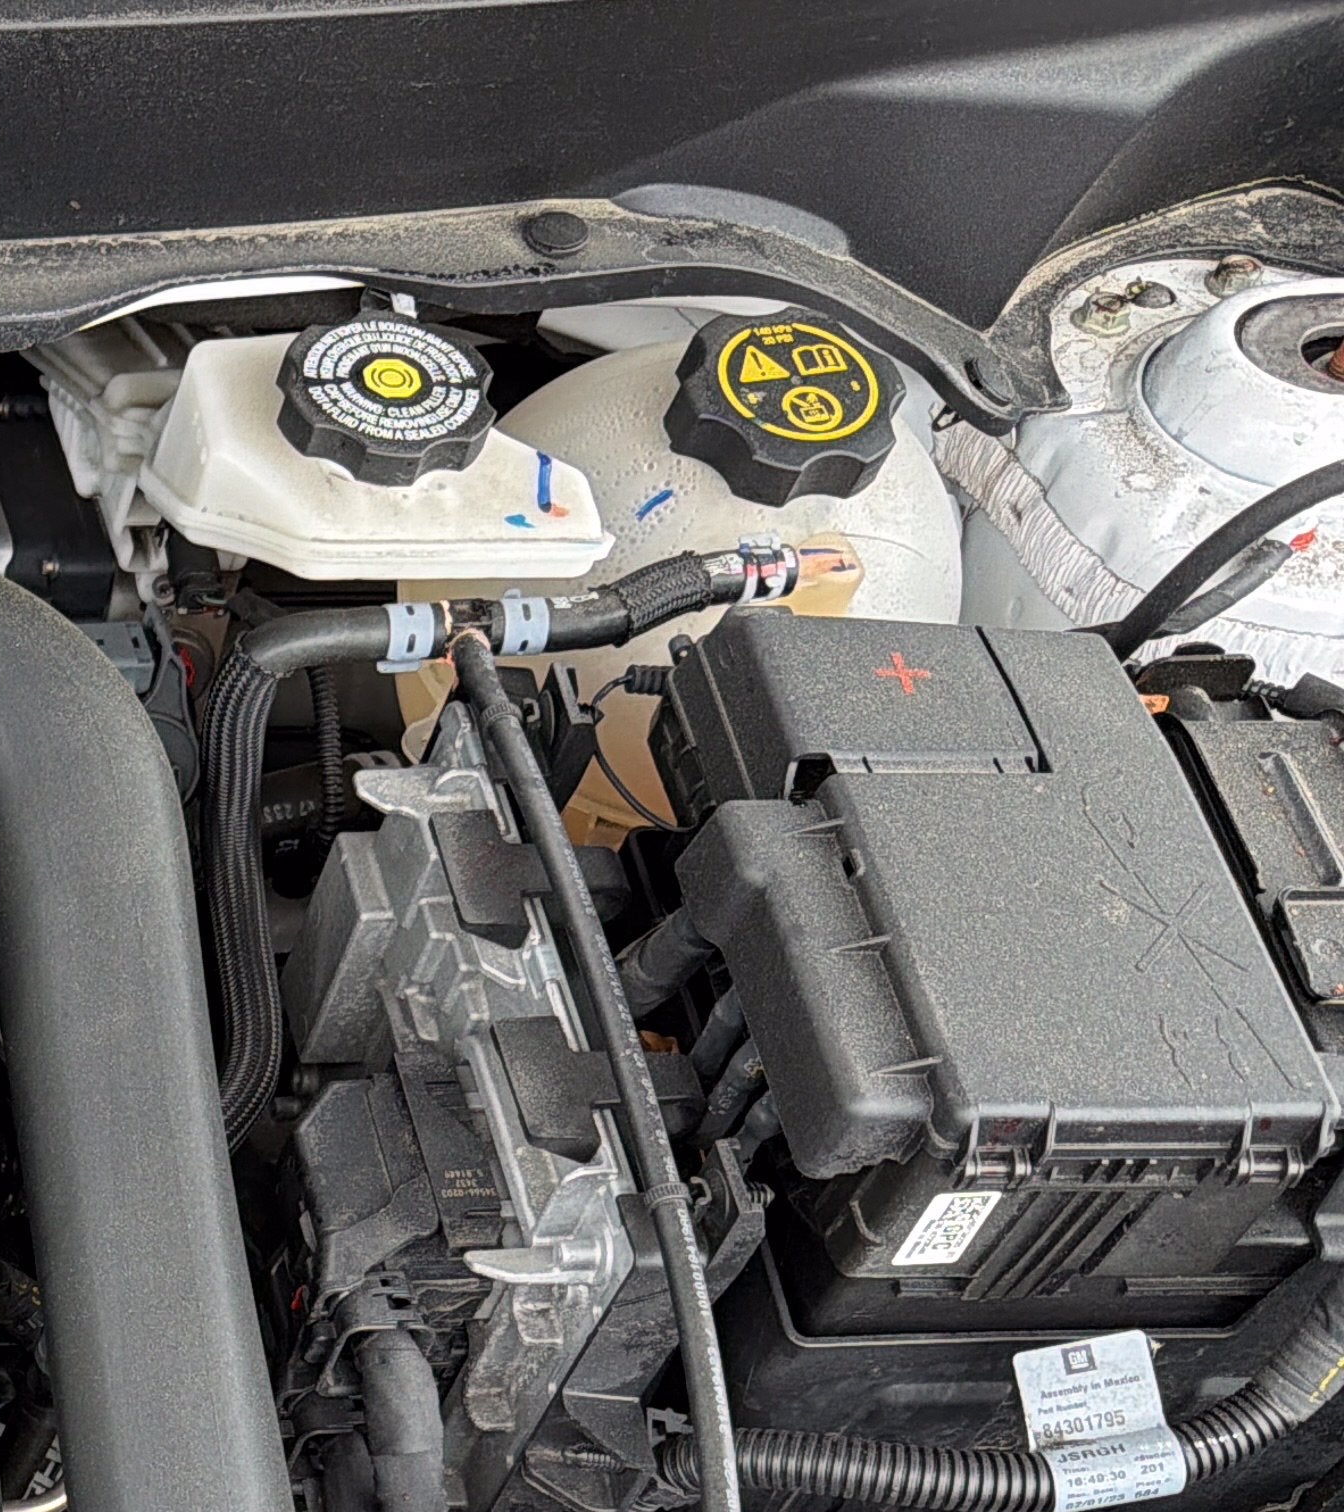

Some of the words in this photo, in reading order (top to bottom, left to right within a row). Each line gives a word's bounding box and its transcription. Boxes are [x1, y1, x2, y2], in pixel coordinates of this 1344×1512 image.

[360, 319, 377, 331] LE
[378, 322, 427, 338] BOUCHON
[422, 330, 457, 354] AVANT
[410, 337, 429, 351] DE
[323, 384, 344, 401] CAP
[337, 398, 379, 425] BEFORE
[445, 387, 462, 410] ONLY
[355, 419, 393, 439] FROM
[404, 424, 448, 440] SEALED
[444, 388, 479, 431] CONTAINER
[386, 402, 428, 417] CLEAN
[427, 385, 446, 412] FILLER
[930, 1224, 964, 1250] GPC
[1068, 1348, 1088, 1367] GM
[1040, 1384, 1088, 1400] Assembly
[1090, 1381, 1102, 1391] in
[1103, 1374, 1140, 1388] Mexico
[1042, 1410, 1126, 1439] 84301795
[1140, 1462, 1165, 1475] 201
